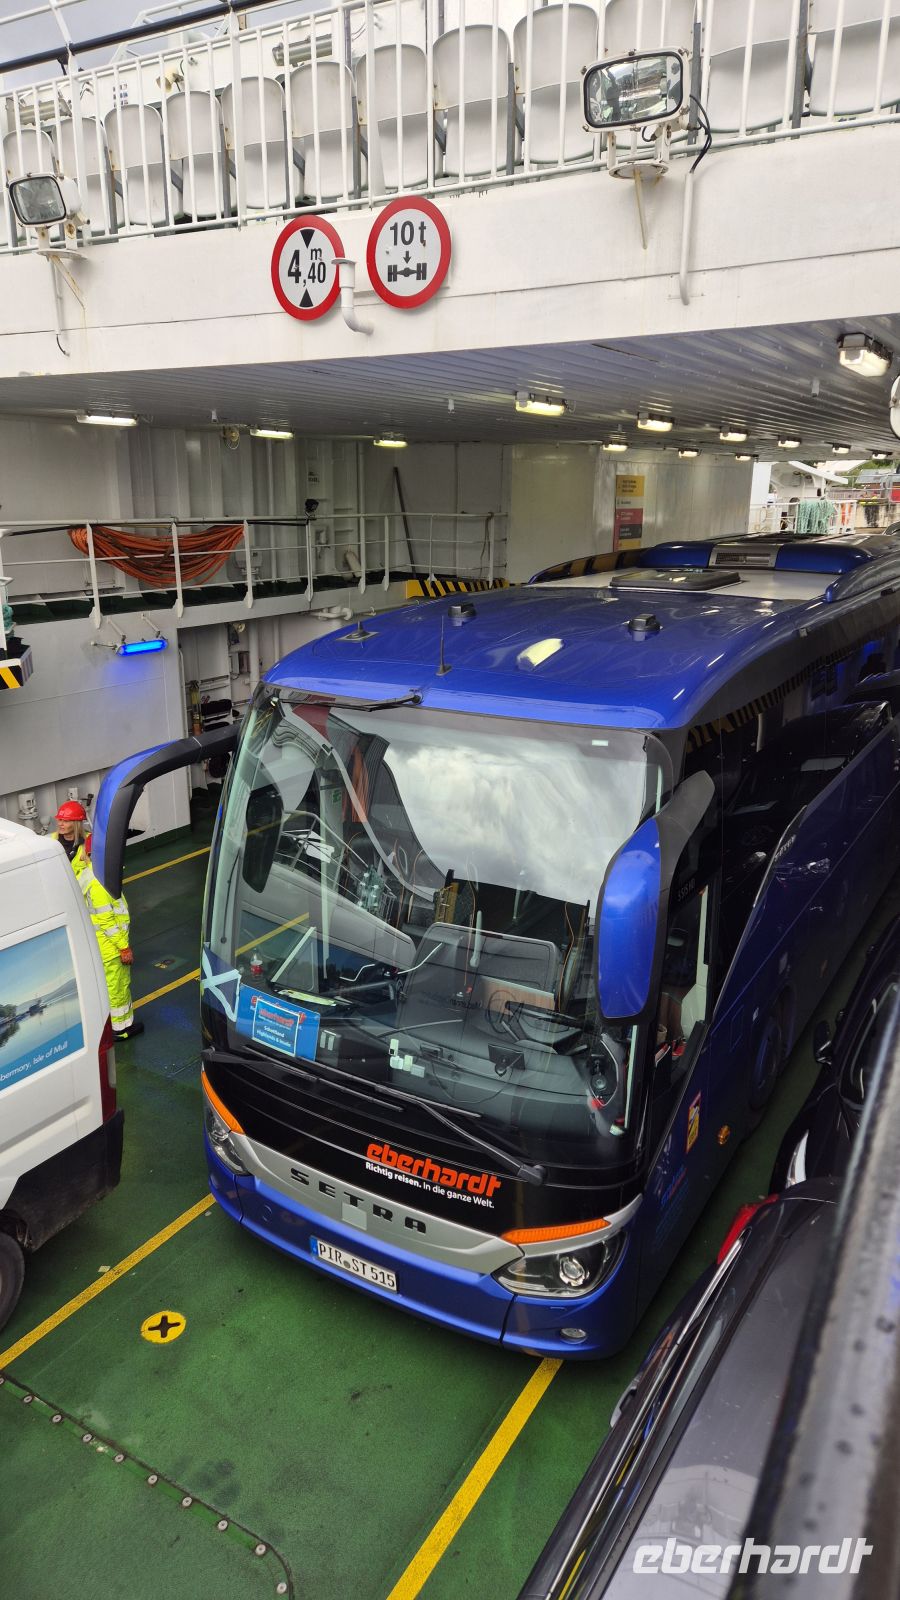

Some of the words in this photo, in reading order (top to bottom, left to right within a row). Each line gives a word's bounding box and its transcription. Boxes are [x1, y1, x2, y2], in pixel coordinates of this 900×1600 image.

[389, 220, 415, 246] 10
[418, 221, 428, 247] t
[287, 249, 327, 287] 4,40
[310, 248, 323, 261] m
[0, 1062, 32, 1081] bermory,
[33, 1054, 45, 1065] Isle
[45, 1049, 53, 1058] of
[53, 1041, 68, 1054] Mull
[365, 1142, 502, 1198] eberhardt
[365, 1161, 394, 1180] Richtig
[394, 1172, 422, 1188] reisen.
[422, 1181, 431, 1191] In
[432, 1185, 446, 1196] die
[446, 1190, 472, 1203] ganze
[472, 1195, 495, 1209] Welt.
[290, 1167, 427, 1234] SETRA
[319, 1242, 343, 1265] PIR
[352, 1258, 367, 1275] ST
[370, 1267, 395, 1288] 515
